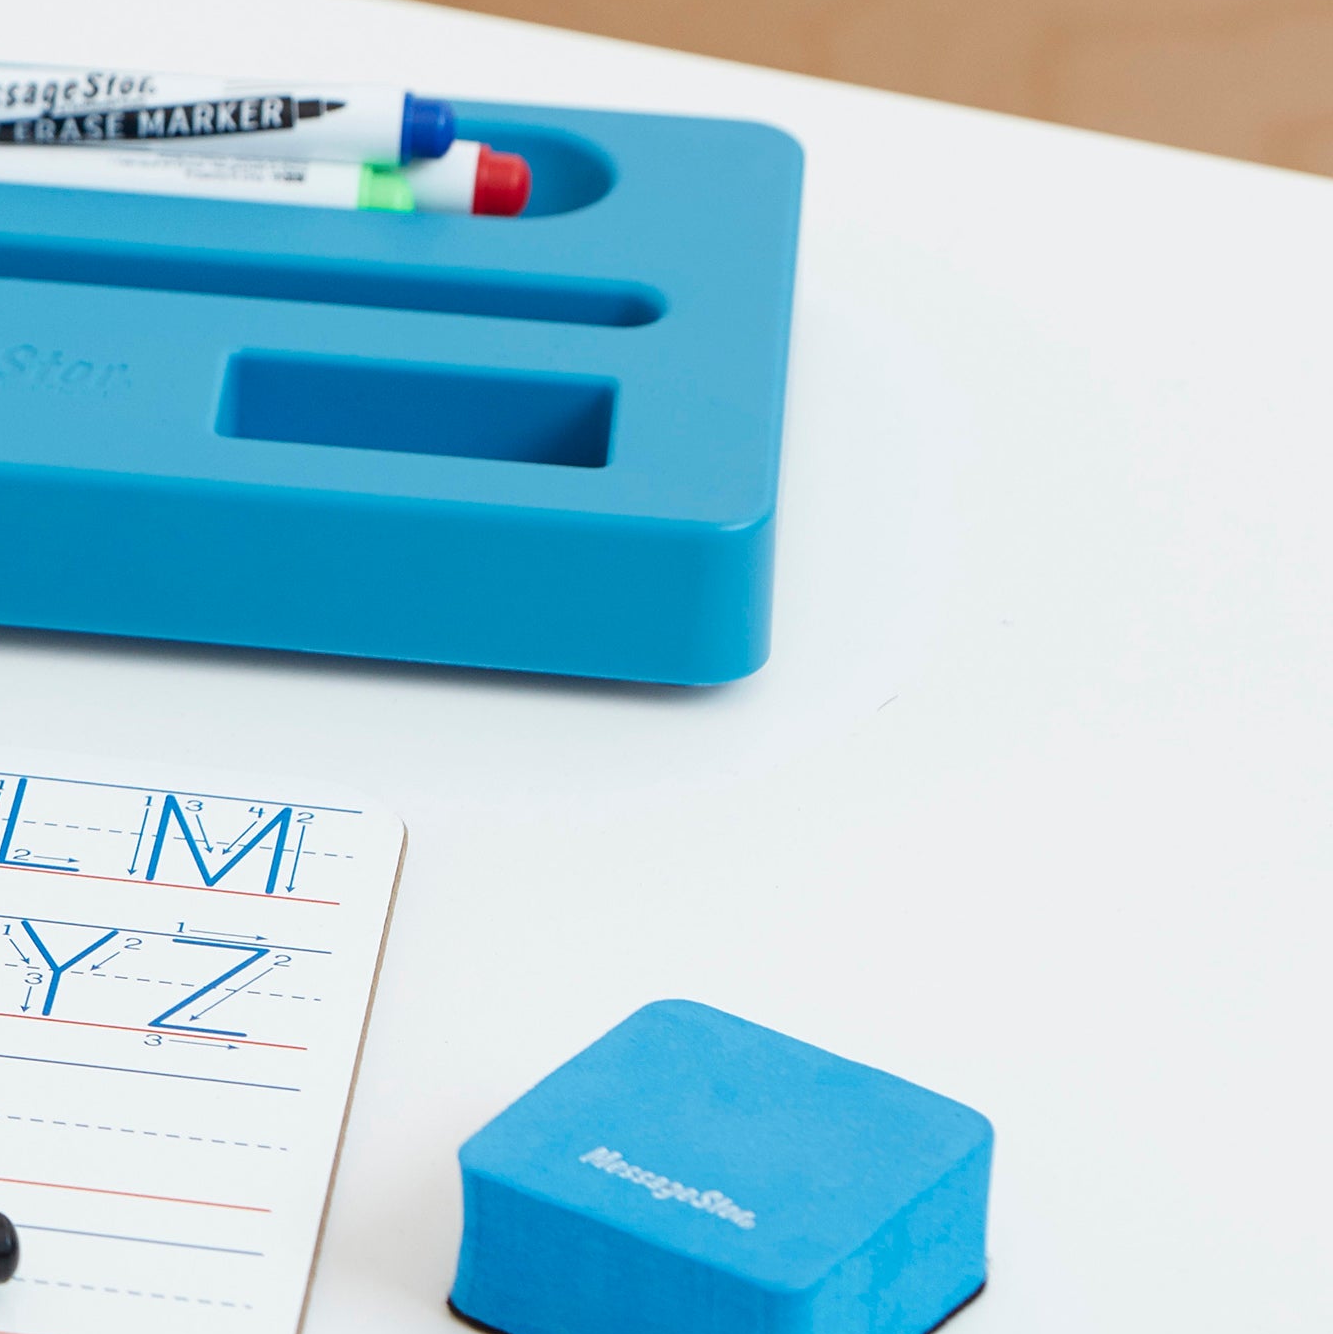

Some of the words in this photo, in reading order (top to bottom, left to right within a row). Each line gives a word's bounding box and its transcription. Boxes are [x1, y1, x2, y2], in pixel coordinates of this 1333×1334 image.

[137, 96, 284, 139] MARKER
[13, 849, 31, 860] 2
[144, 795, 153, 807] 1
[185, 800, 204, 812] 3
[249, 806, 265, 818] 4
[296, 812, 315, 824] 2
[145, 794, 293, 895] M
[2, 924, 12, 936] 1
[24, 972, 43, 985] 3
[124, 937, 143, 950] 2
[144, 1034, 162, 1046] 3
[176, 922, 185, 933] 1
[273, 955, 292, 967] 2
[21, 920, 119, 1016] Y
[147, 938, 271, 1037] Z
